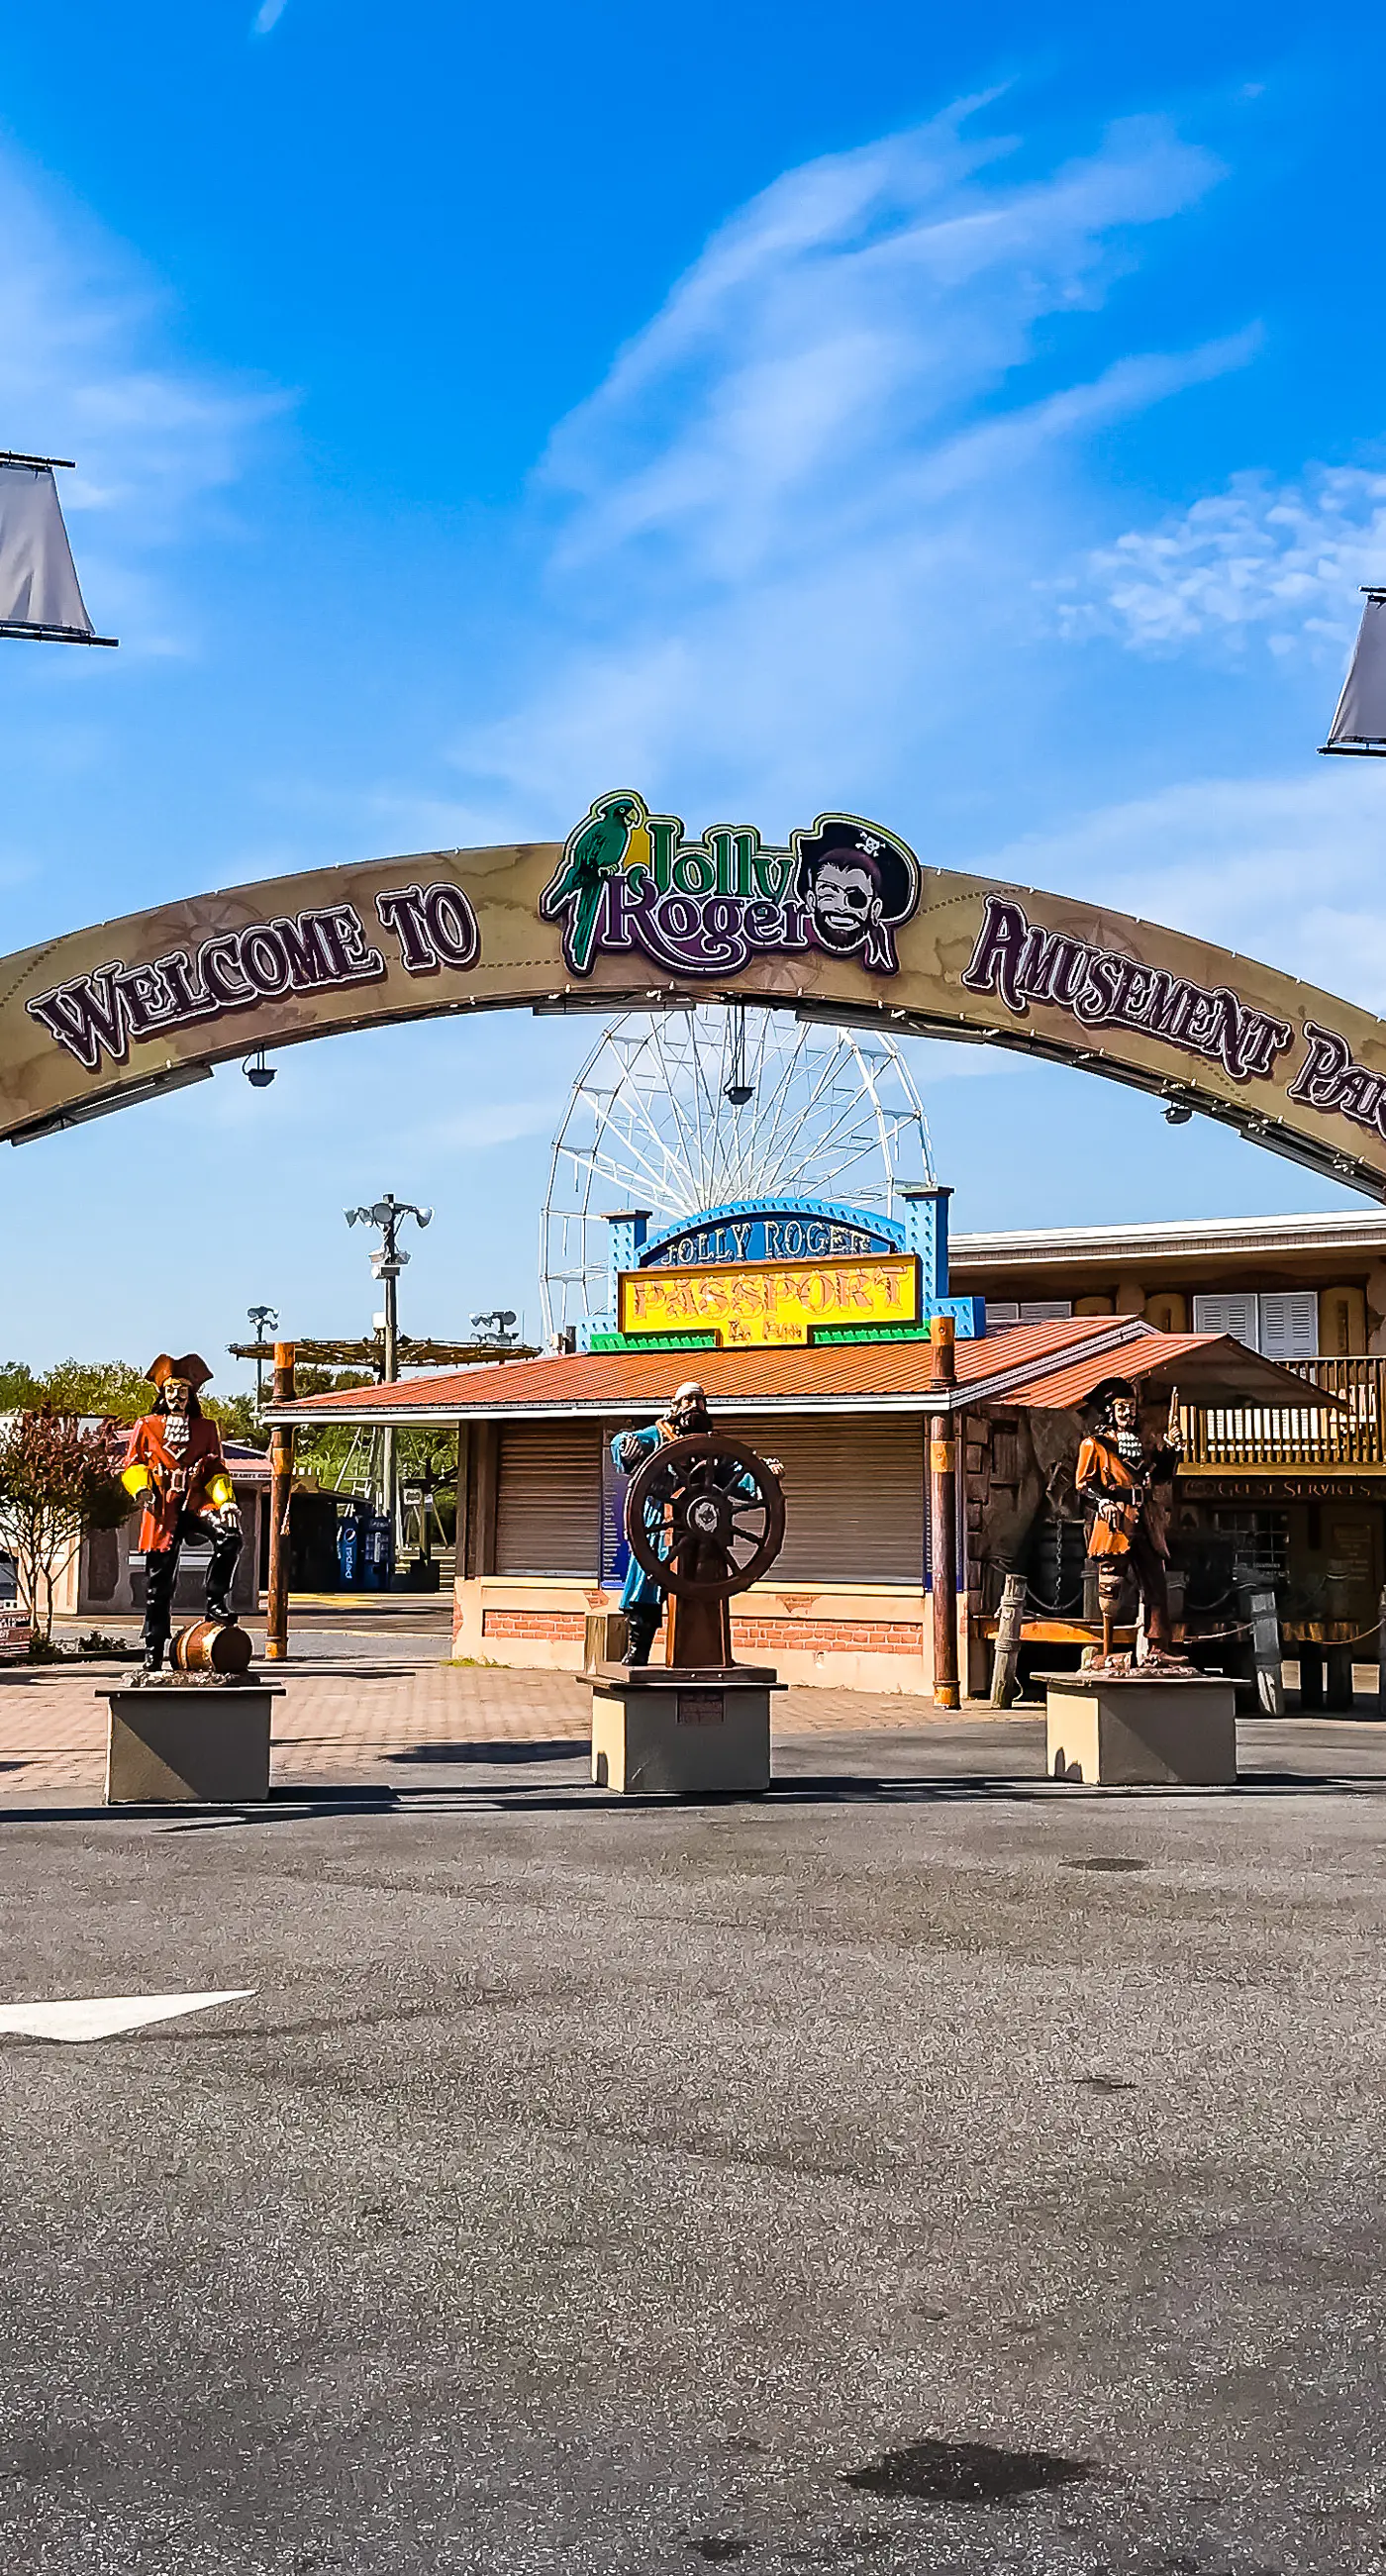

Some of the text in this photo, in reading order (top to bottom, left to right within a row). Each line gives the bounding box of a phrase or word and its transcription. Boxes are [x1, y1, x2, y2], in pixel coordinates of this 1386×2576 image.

[624, 823, 795, 903] Jolly
[602, 875, 810, 970] Roger
[27, 882, 480, 1068] WELCOME TO
[962, 895, 1291, 1079] AMUSEMENT
[661, 1221, 871, 1266] JOLLY ROGER
[632, 1265, 908, 1321] PASSPORT
[1283, 1480, 1371, 1497] SERVICES
